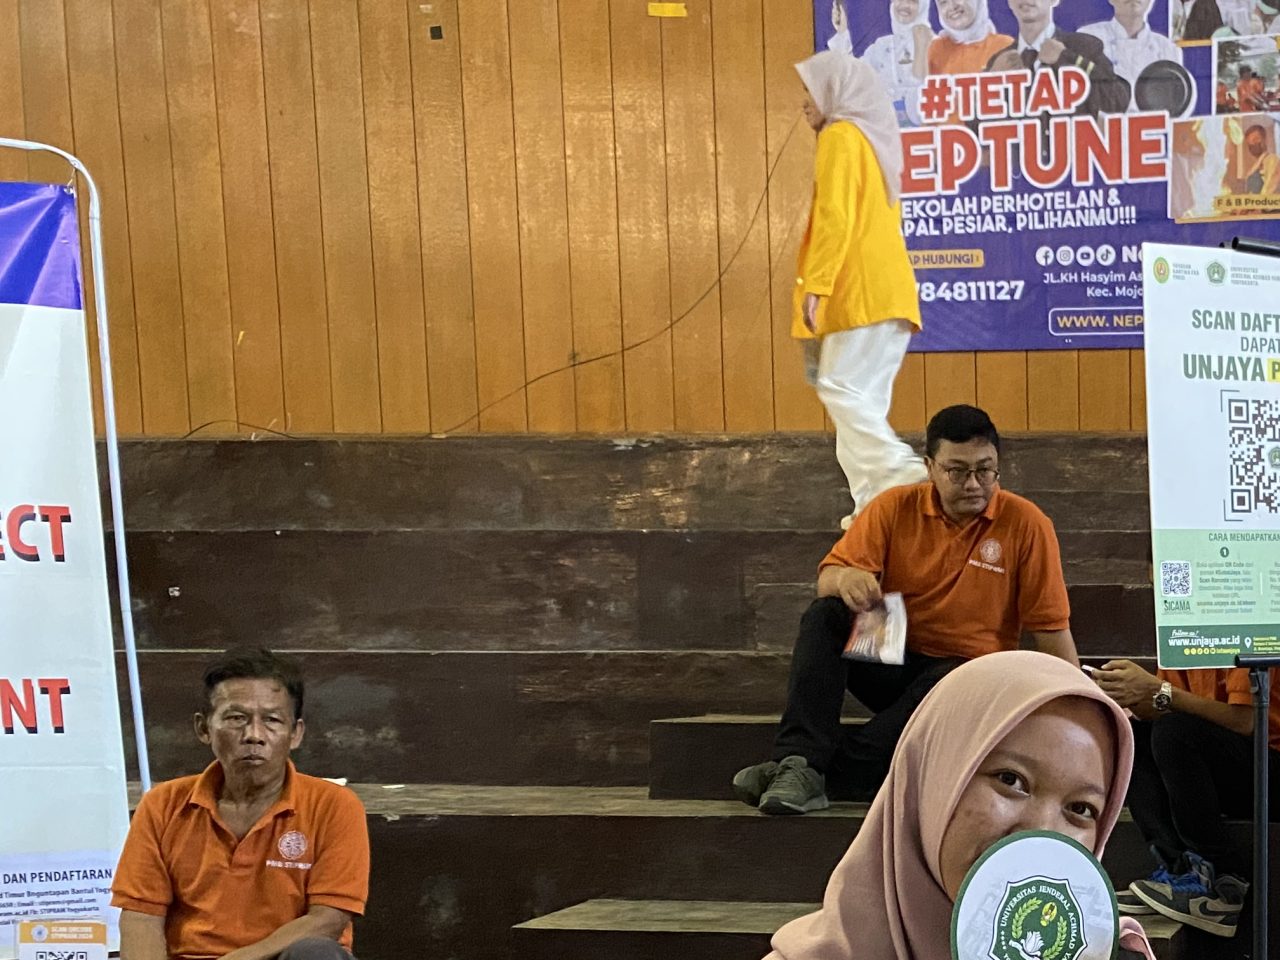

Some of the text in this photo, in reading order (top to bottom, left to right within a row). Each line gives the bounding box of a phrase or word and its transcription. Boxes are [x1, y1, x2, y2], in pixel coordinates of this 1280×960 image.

[919, 68, 1089, 121] #TETAP
[981, 190, 1104, 215] PERHOTELAN
[1108, 188, 1120, 206] &
[943, 215, 1013, 235] PESIAR,
[1016, 206, 1136, 232] PILIHANMU!!!
[1043, 272, 1078, 284] JL.KH
[1081, 271, 1126, 285] Hasyim
[1086, 286, 1113, 297] Kec.
[1057, 315, 1109, 328] WWW.
[1191, 309, 1236, 330] SCAN
[1183, 353, 1265, 382] UNJAYA
[0, 504, 72, 563] CT
[1208, 532, 1229, 542] CARA
[1163, 600, 1191, 611] SICAMA
[1168, 635, 1241, 648] www.unjaya.ac.id
[3, 869, 113, 884] DAN PENDAFTARAN
[1001, 885, 1037, 926] UNIVERSITAS
[1038, 885, 1070, 911] JENDERAL
